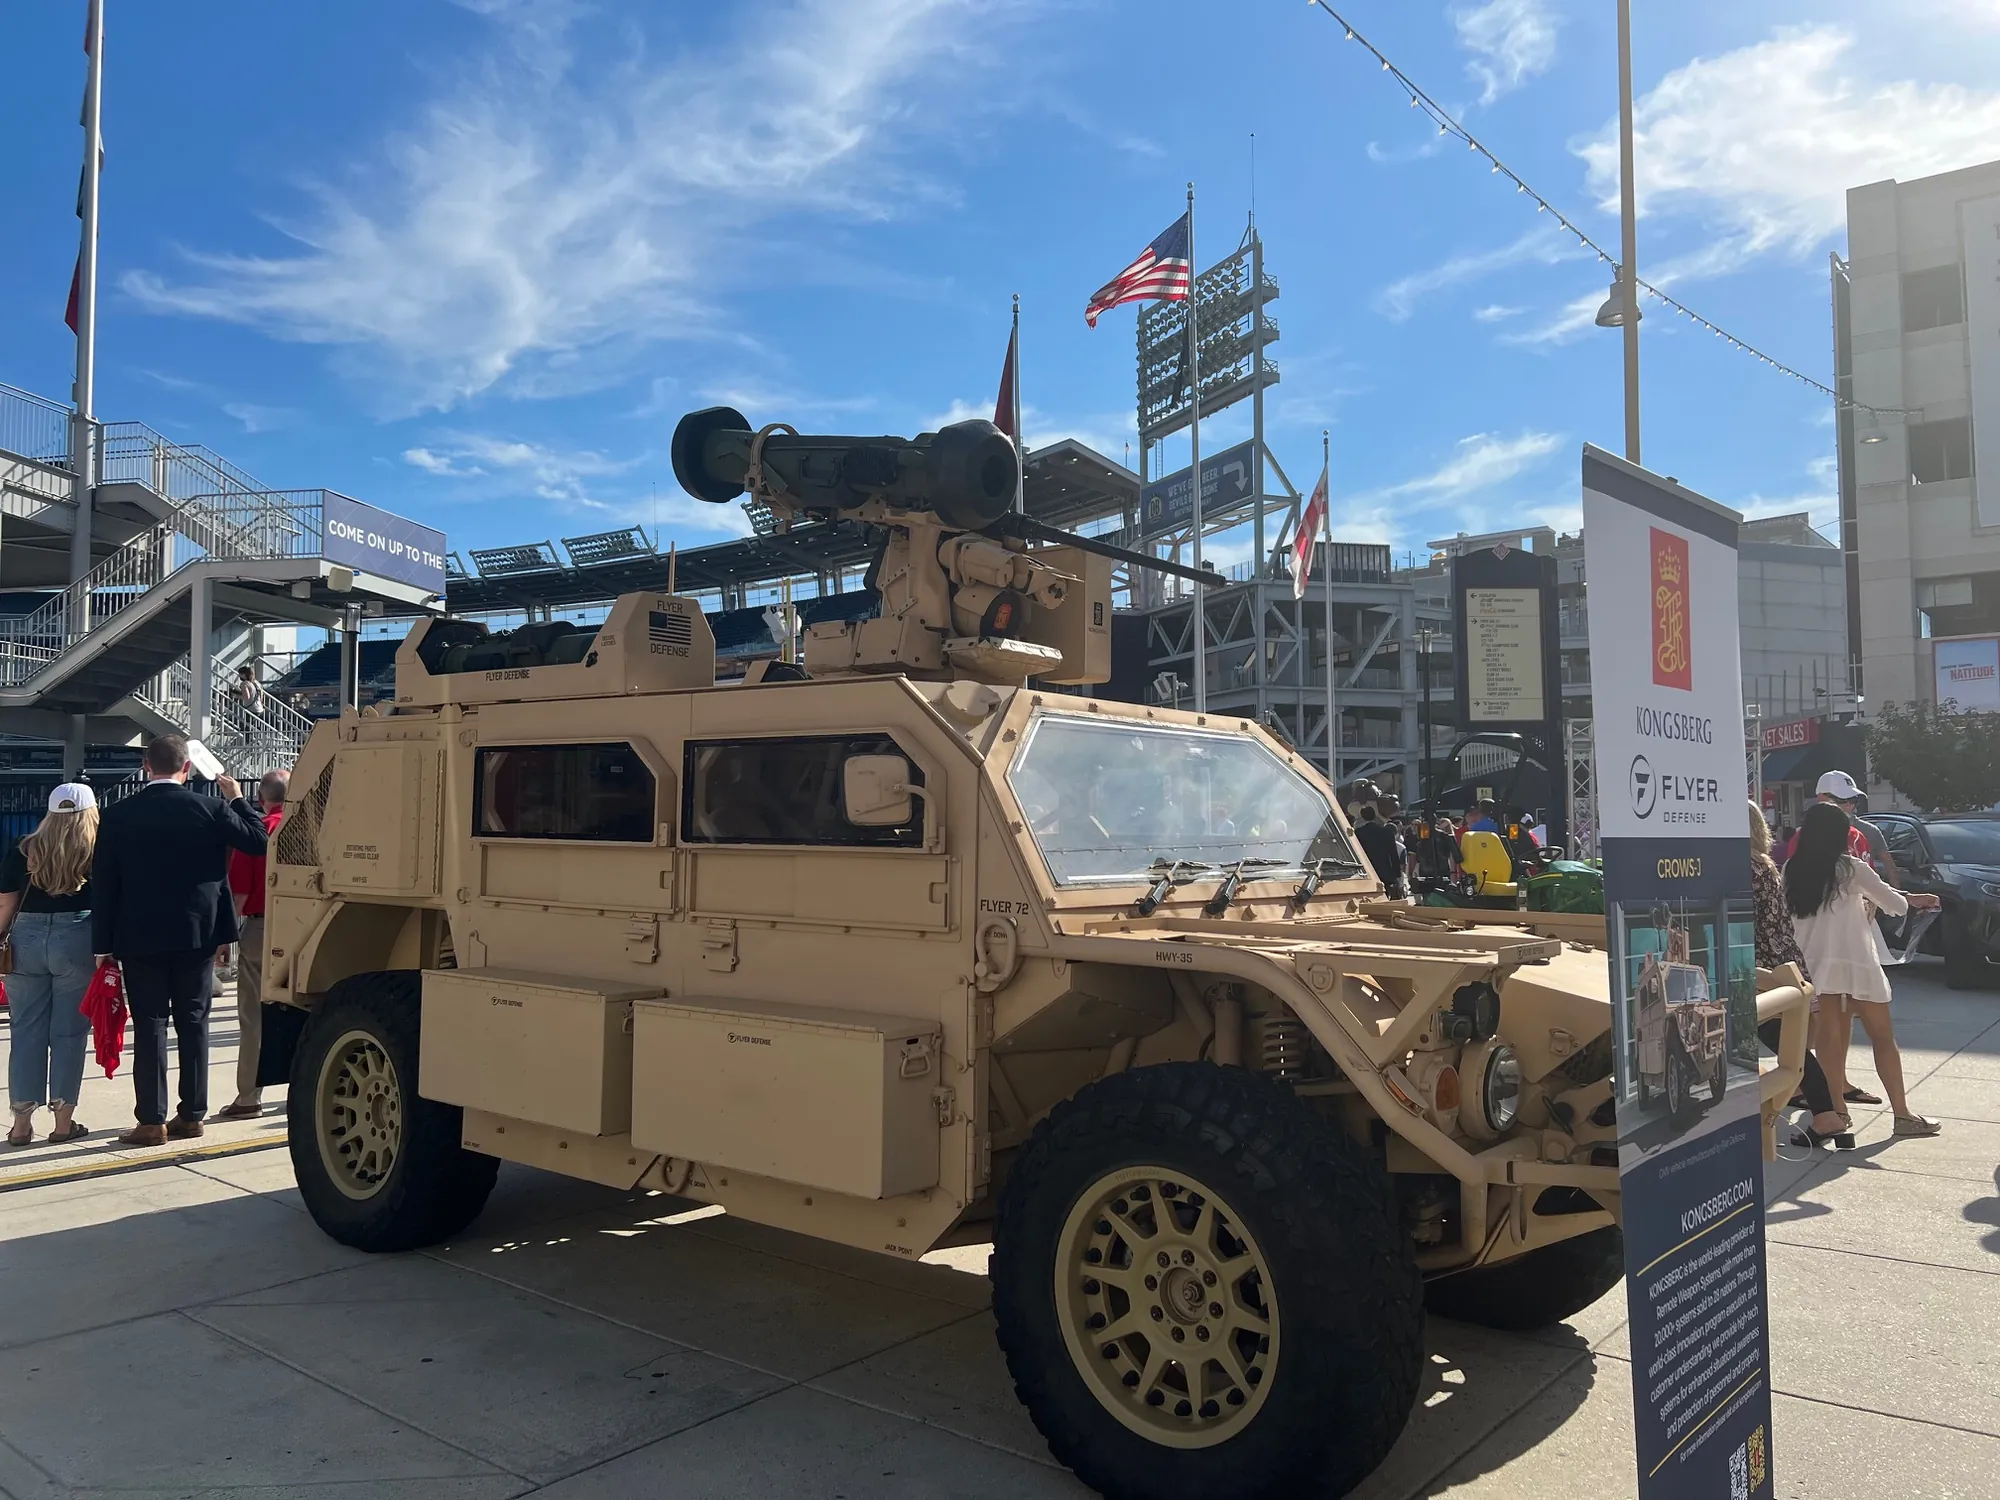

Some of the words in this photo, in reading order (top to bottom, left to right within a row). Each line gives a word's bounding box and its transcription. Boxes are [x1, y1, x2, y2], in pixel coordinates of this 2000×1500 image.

[1201, 468, 1218, 482] BEER
[1168, 494, 1188, 511] DEVILS
[328, 520, 364, 544] COME
[367, 532, 386, 552] ON
[388, 539, 404, 556] UP
[405, 545, 420, 562] TO
[422, 550, 443, 570] THE
[657, 600, 684, 614] FLYER
[650, 643, 690, 658] DEFENSE
[486, 671, 502, 681] FLYER
[504, 670, 530, 680] DEFENSE
[1950, 666, 1994, 680] NATITUDE
[1636, 706, 1712, 745] KONGSBERG
[1778, 723, 1804, 745] SALES
[1662, 775, 1718, 802] FLYER
[1664, 812, 1706, 824] DEFENSE
[1657, 858, 1701, 879] CROWS-J
[980, 899, 1012, 913] FLYER
[1016, 902, 1029, 915] 72
[1156, 950, 1192, 963] HWY-35
[751, 1037, 772, 1046] DEFENSE
[1680, 1178, 1753, 1234] KONGSBERG.COM
[884, 1244, 896, 1252] JACK
[898, 1246, 913, 1256] POINT
[1648, 1266, 1684, 1300] KONGSBERG
[1688, 1258, 1698, 1274] the
[1697, 1238, 1730, 1268] world-leading
[1730, 1226, 1749, 1250] provider
[1749, 1220, 1756, 1234] of
[1656, 1296, 1678, 1320] Remote
[1677, 1281, 1700, 1304] Weapon
[1722, 1258, 1732, 1275] with
[1732, 1251, 1744, 1268] more
[1744, 1244, 1756, 1259] than
[1675, 1308, 1697, 1332] systems
[1696, 1296, 1708, 1315] sold
[1736, 1262, 1757, 1285] Through
[1648, 1346, 1677, 1378] world-class
[1704, 1310, 1726, 1336] program
[1748, 1282, 1758, 1298] and
[1650, 1372, 1674, 1403] customer
[1712, 1337, 1720, 1350] we
[1720, 1321, 1738, 1348] provide
[1737, 1304, 1759, 1330] high-tech
[1660, 1392, 1680, 1422] systems
[1680, 1386, 1688, 1401] for
[1688, 1362, 1714, 1394] enhanced
[1713, 1342, 1736, 1372] situational
[1736, 1326, 1760, 1352] awareness
[1666, 1420, 1677, 1439] and
[1677, 1398, 1704, 1432] protection
[1704, 1388, 1710, 1404] of
[1710, 1368, 1732, 1403] personnel
[1732, 1361, 1741, 1380] and
[1686, 1442, 1696, 1458] more
[1696, 1423, 1716, 1450] information
